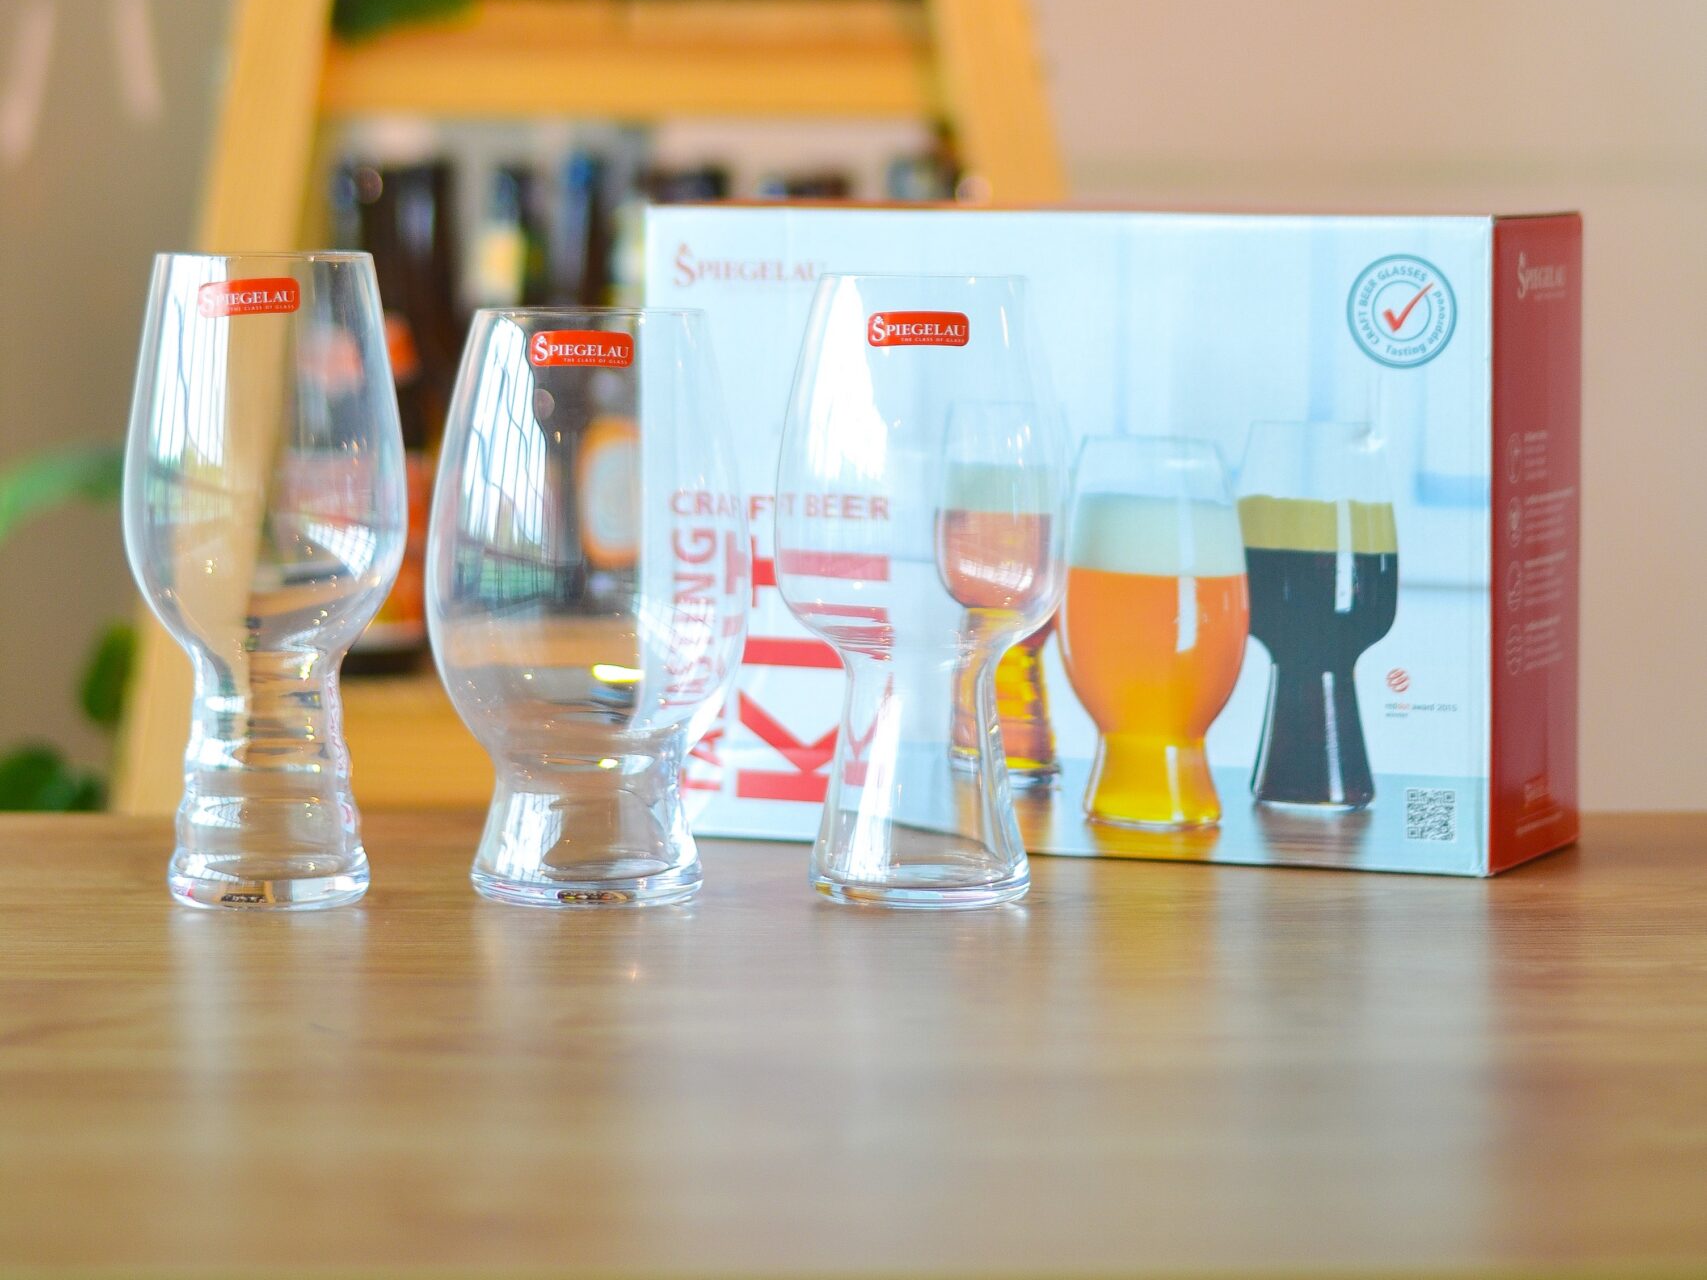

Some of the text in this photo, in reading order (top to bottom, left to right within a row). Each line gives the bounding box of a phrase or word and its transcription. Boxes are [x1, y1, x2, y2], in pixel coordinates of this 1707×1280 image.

[672, 242, 828, 287] SPIEGELAU
[1358, 266, 1428, 345] CRAFT BEER GLASSES
[1386, 290, 1445, 356] Tasting approved
[872, 316, 966, 341] SPIEGELAU
[534, 335, 629, 362] SPIEGELAU
[669, 490, 889, 520] CRAFT BEER
